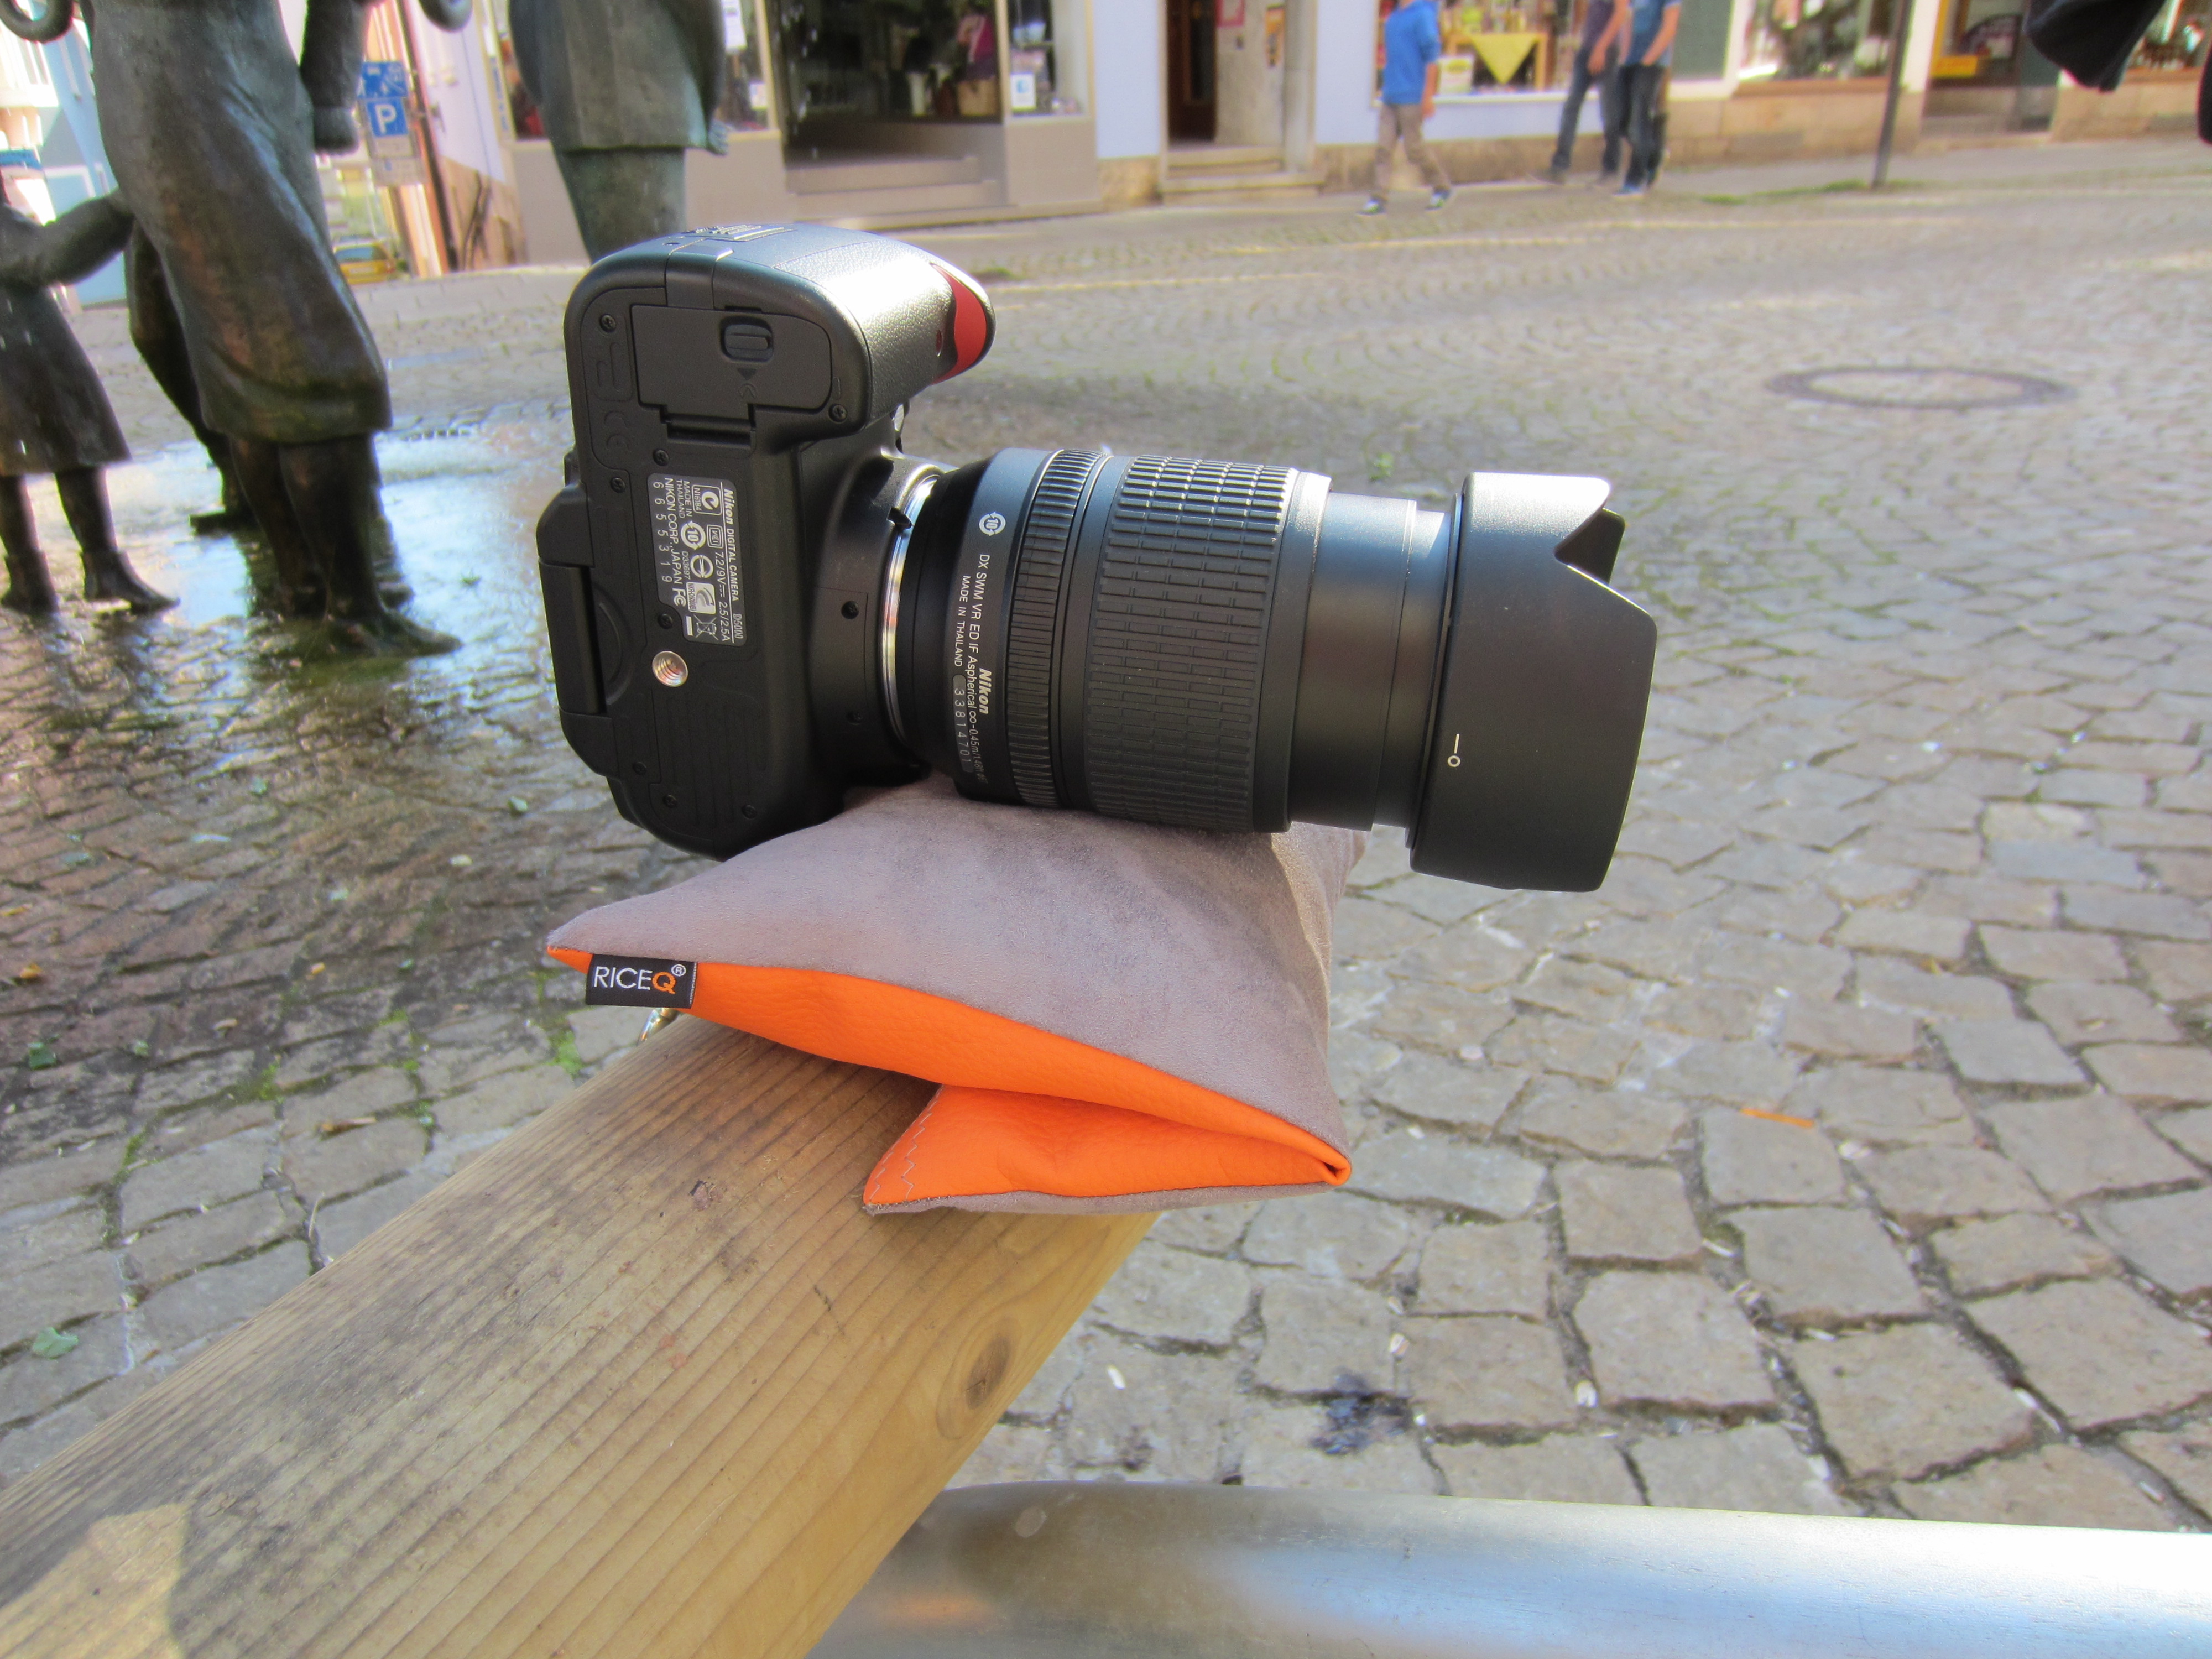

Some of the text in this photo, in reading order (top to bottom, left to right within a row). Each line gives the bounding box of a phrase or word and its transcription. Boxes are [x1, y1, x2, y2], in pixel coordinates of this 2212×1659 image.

[375, 104, 397, 134] P
[664, 478, 676, 511] NIKON
[676, 479, 685, 519] THAILAND
[683, 481, 692, 517] MADE IN
[687, 530, 698, 542] 10
[985, 518, 999, 529] 10
[682, 551, 691, 580] D33697
[724, 488, 743, 639] Nikon DIGITAL CAMERA D5000
[978, 554, 990, 570] DX
[973, 571, 987, 600] SWM
[719, 602, 731, 641] 2.5/2.5A
[954, 575, 971, 667] MADE IN THAILAND
[971, 603, 983, 620] VR
[969, 624, 980, 640] ED
[968, 643, 979, 653] IF
[965, 656, 978, 709] Aspherical
[978, 668, 992, 714] Nikon
